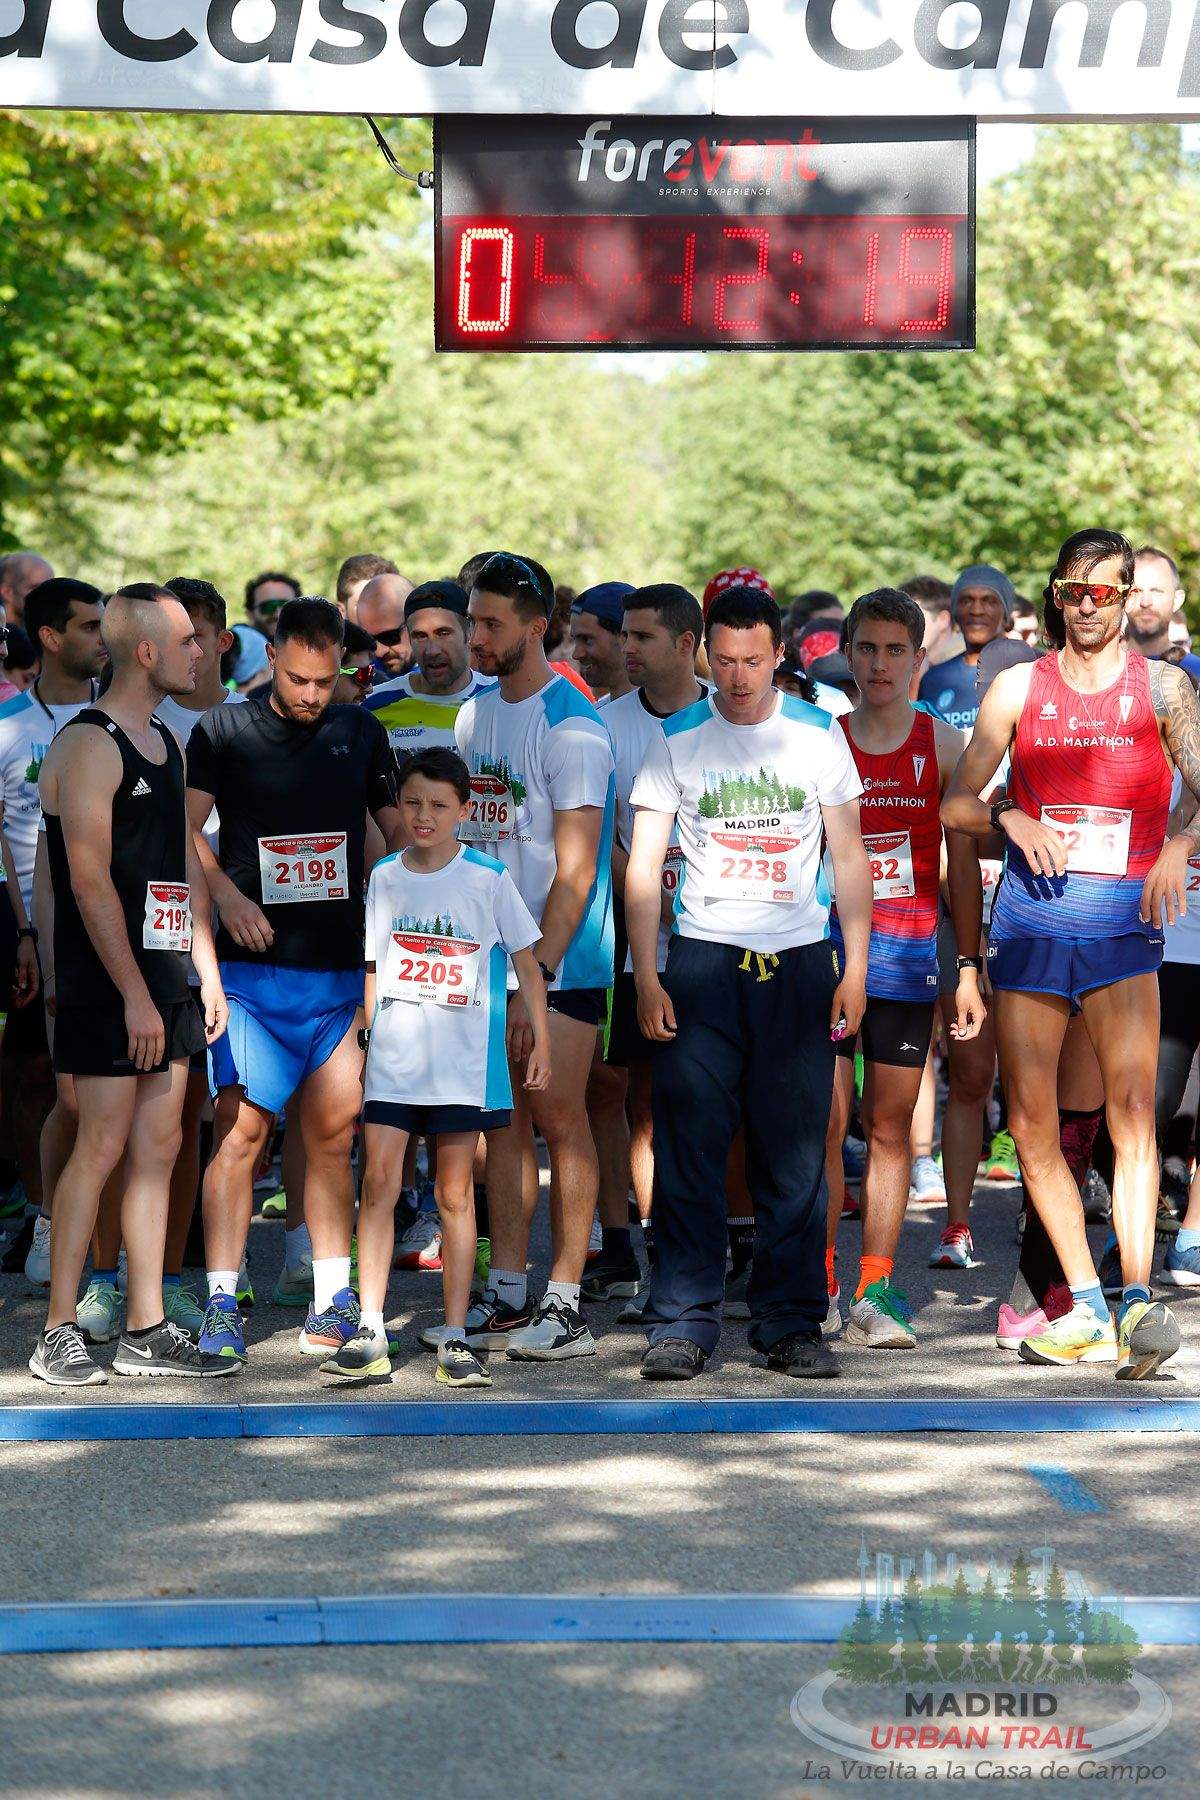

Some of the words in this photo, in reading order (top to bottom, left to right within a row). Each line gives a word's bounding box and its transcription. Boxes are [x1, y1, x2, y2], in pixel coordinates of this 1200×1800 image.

[96, 0, 496, 68] Casa
[551, 0, 750, 71] de
[805, 0, 1200, 98] Cam
[577, 120, 822, 184] forevent
[659, 188, 700, 196] SPORTS
[706, 188, 772, 196] EXPERIENCE
[1034, 737, 1060, 747] A.D.
[1063, 736, 1134, 747] MARATHON
[131, 787, 152, 797] adidas
[872, 777, 901, 790] alquiber
[470, 800, 508, 823] 2196
[859, 797, 926, 808] MARATHON
[724, 817, 781, 830] MADRID
[274, 859, 337, 884] 2198
[720, 857, 787, 883] 2238
[398, 958, 463, 986] 2205
